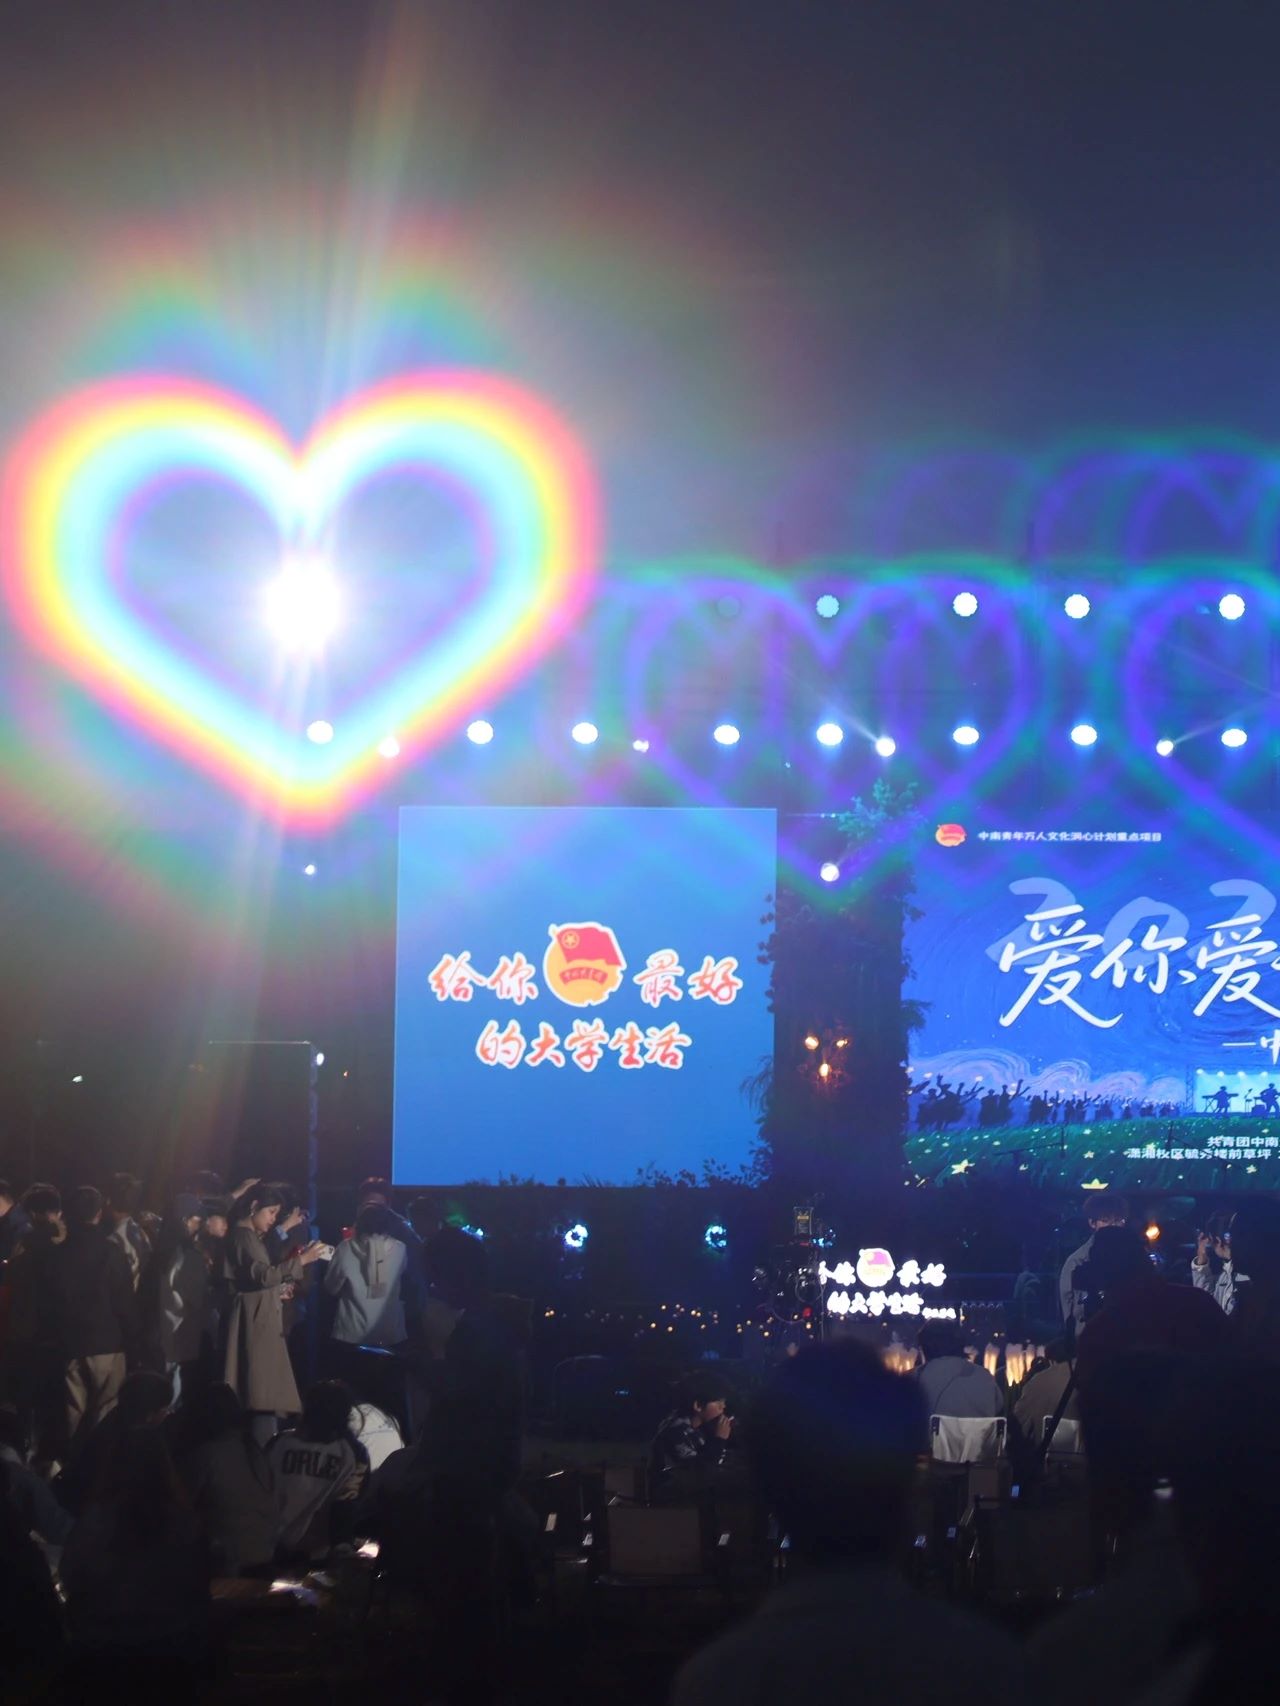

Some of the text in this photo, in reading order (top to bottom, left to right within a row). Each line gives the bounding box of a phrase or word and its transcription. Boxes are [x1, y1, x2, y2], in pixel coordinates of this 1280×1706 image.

[428, 948, 743, 1008] 给你 最好
[475, 1018, 692, 1073] 的大学生活
